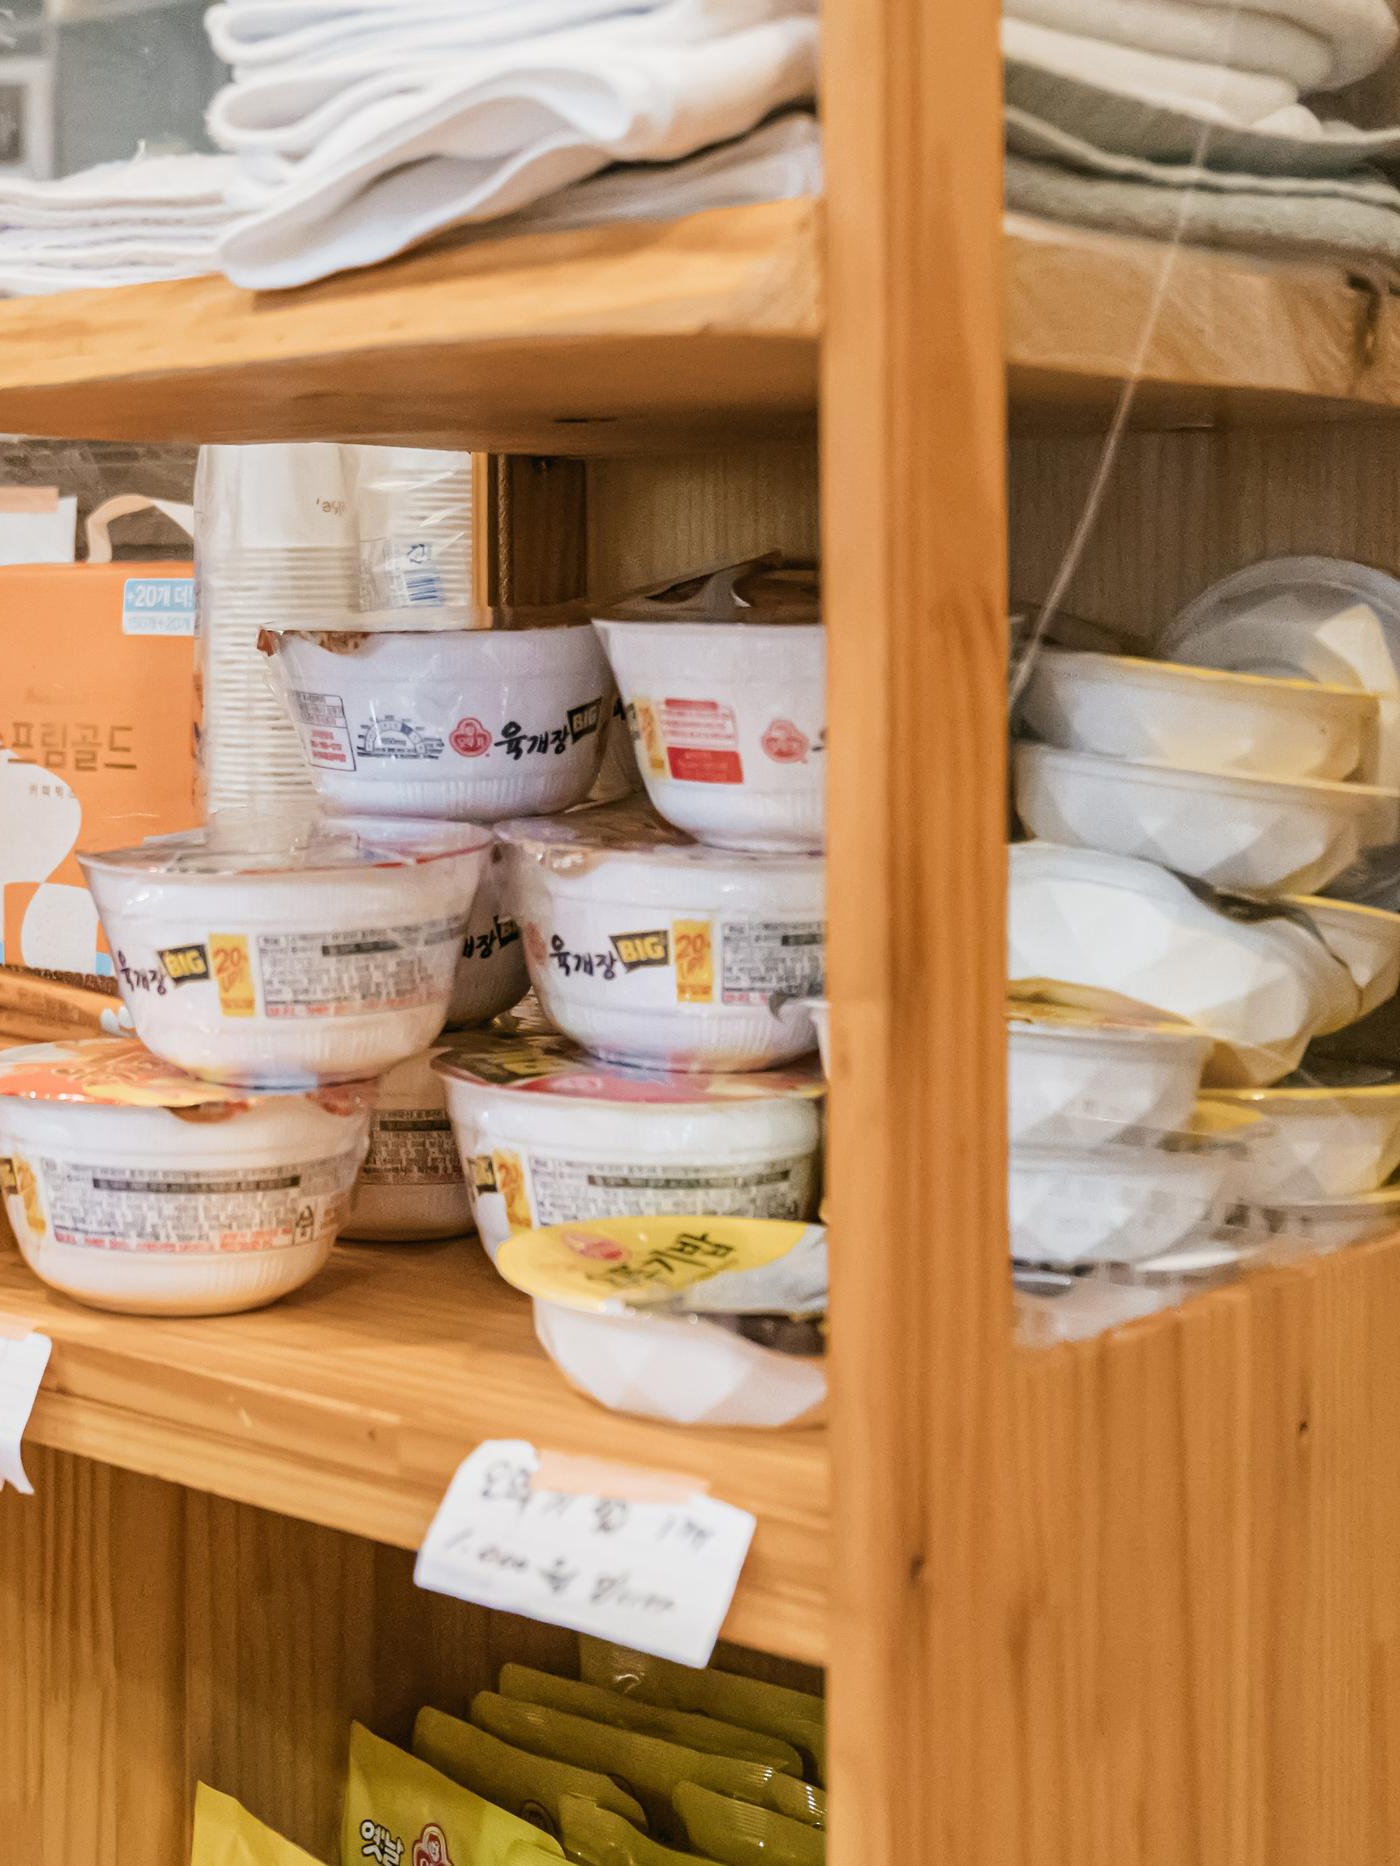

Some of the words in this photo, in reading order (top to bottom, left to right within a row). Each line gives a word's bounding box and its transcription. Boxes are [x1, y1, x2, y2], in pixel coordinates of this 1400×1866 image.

[494, 720, 569, 761] 육개장
[572, 706, 599, 735] BIG
[164, 948, 207, 979] BIG
[549, 934, 617, 981] 육개장
[616, 937, 665, 963] BIG
